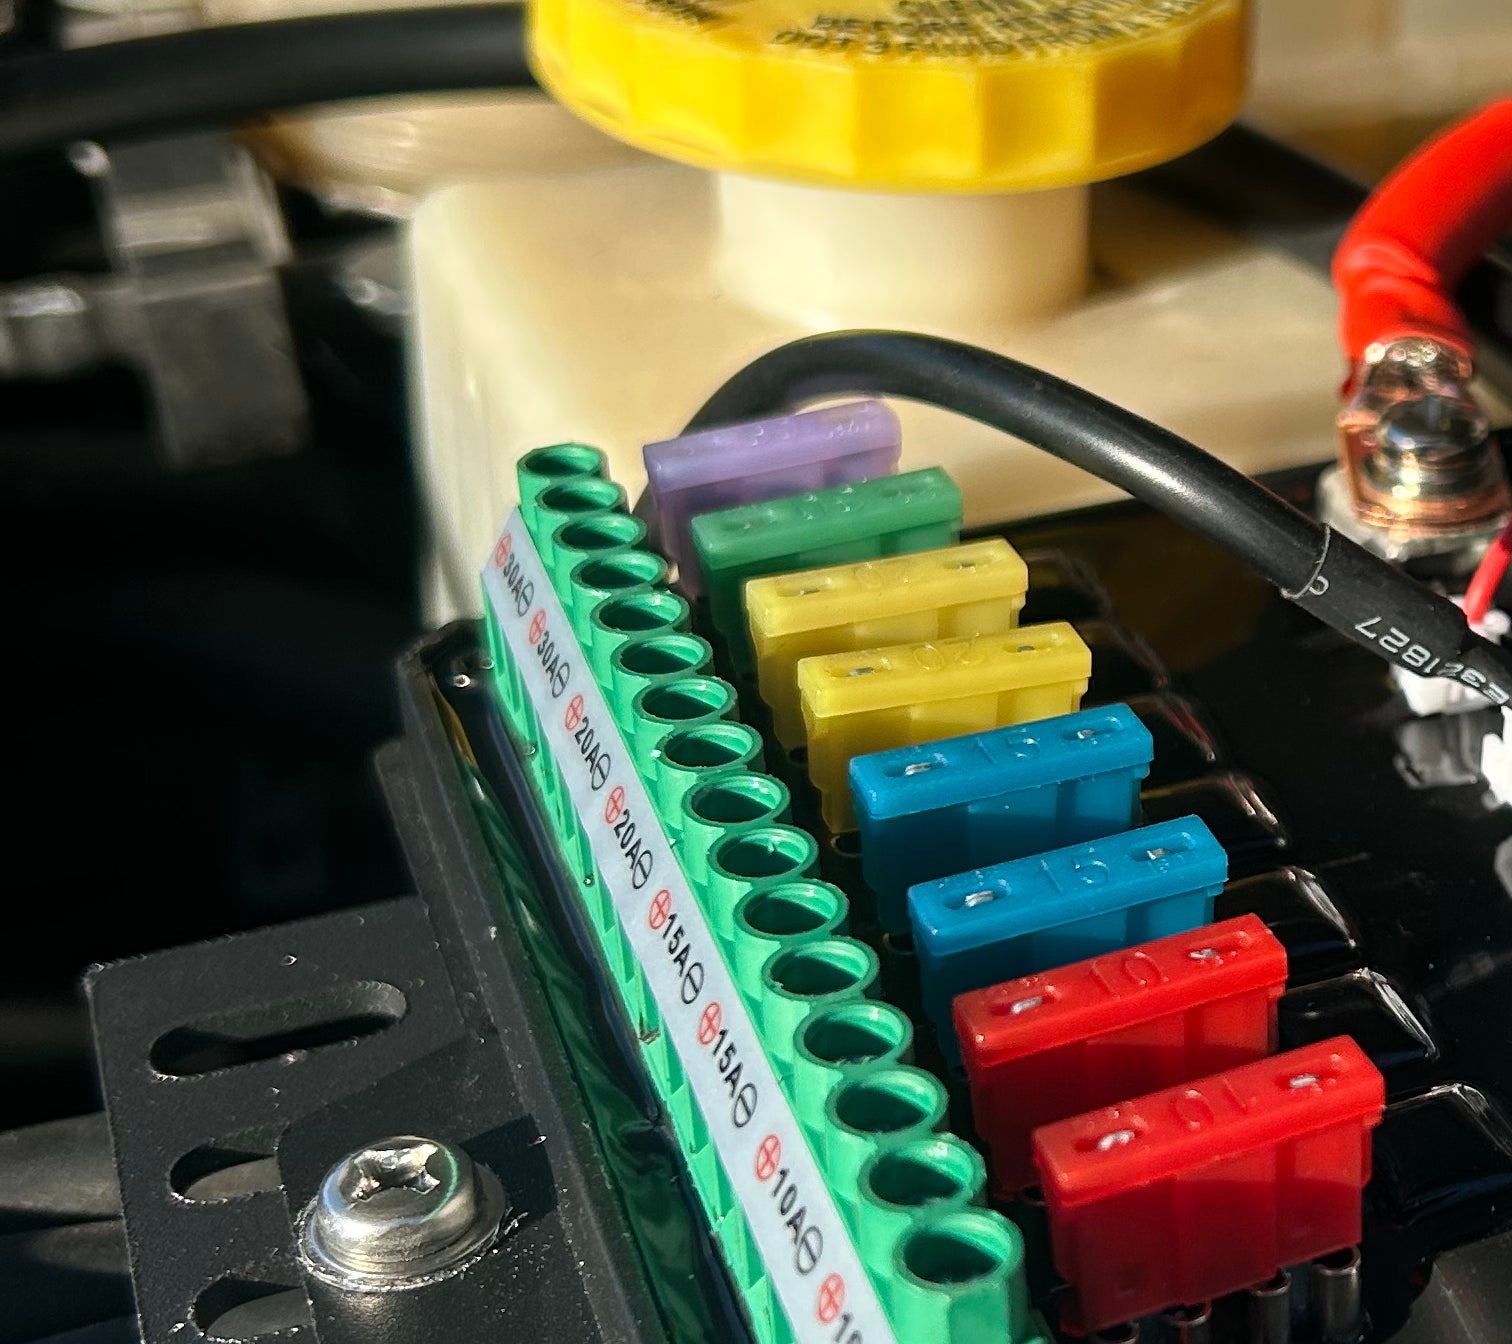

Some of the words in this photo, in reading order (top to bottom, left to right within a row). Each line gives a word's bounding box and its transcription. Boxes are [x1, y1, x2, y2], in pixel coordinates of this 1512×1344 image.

[502, 551, 527, 601] 30A
[538, 630, 563, 679] 30A
[573, 716, 604, 771] 20A
[613, 807, 646, 870] 20A
[662, 912, 693, 976] 15A
[711, 1029, 744, 1097] 15A
[771, 1169, 808, 1245] 10A
